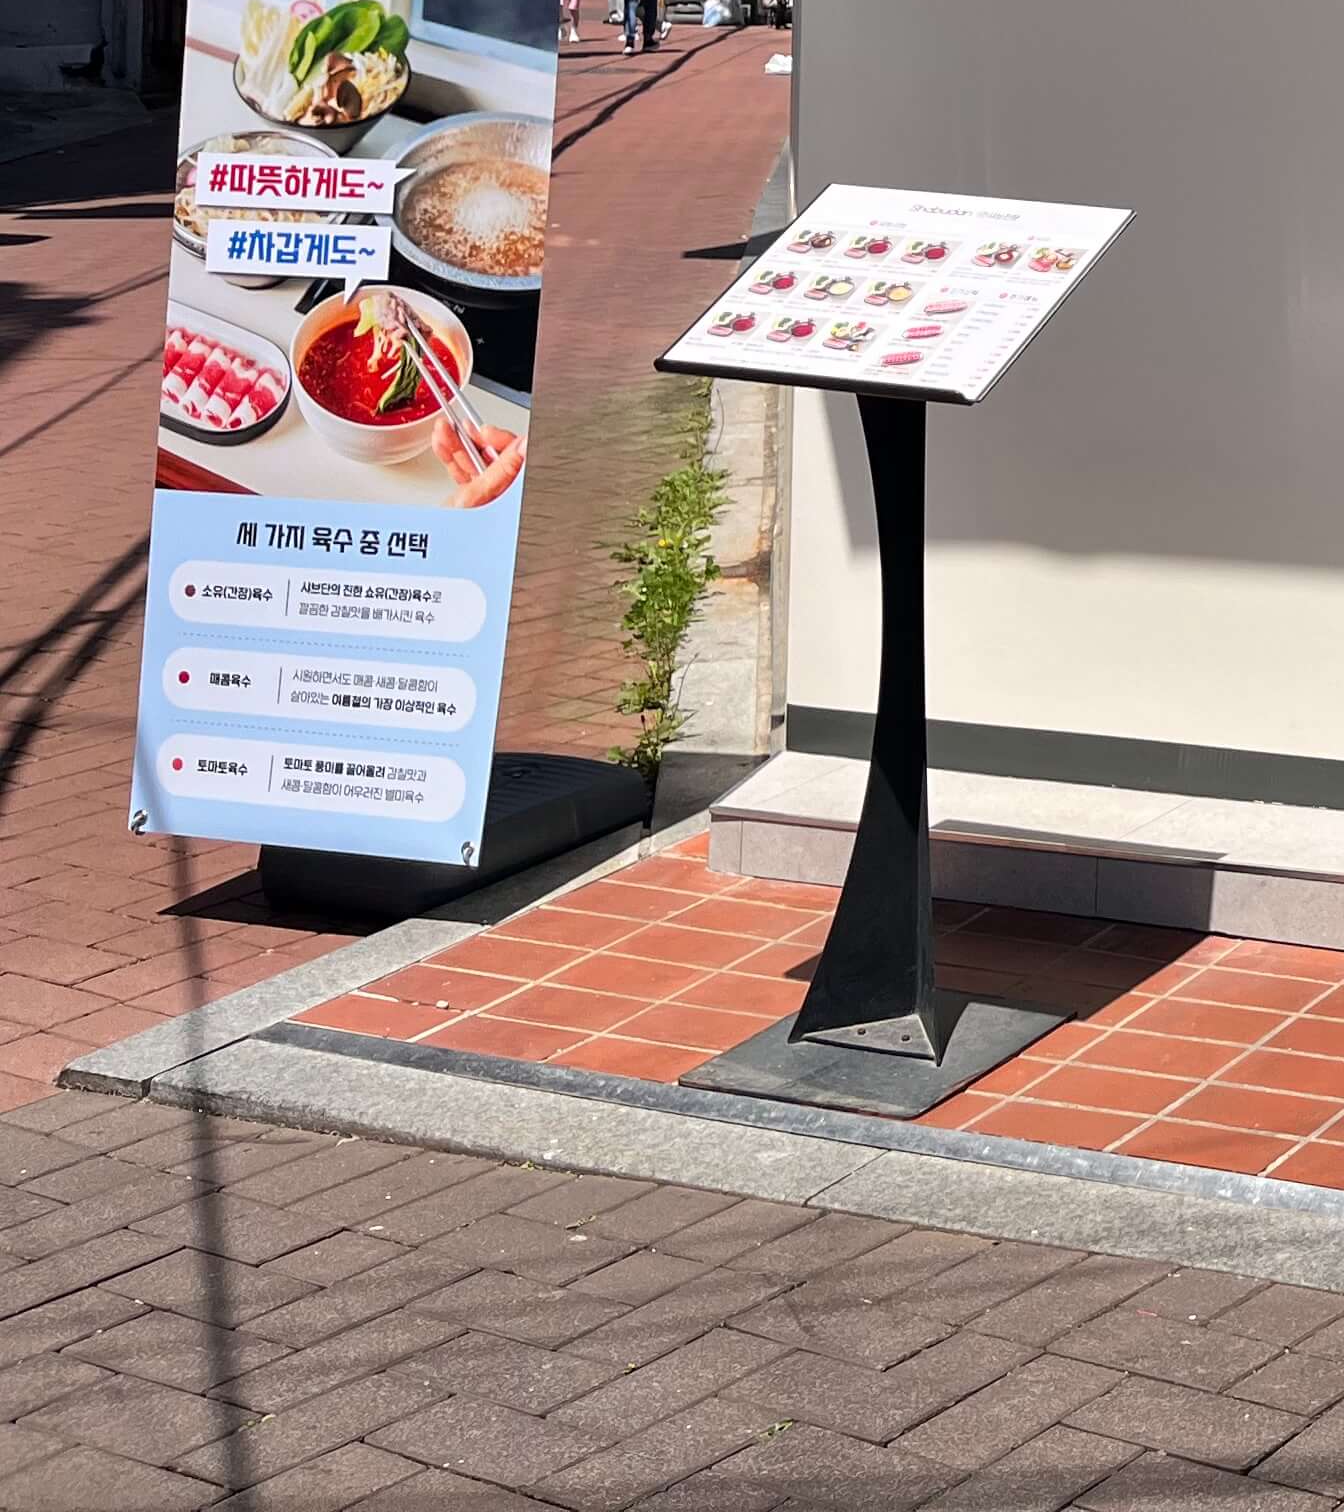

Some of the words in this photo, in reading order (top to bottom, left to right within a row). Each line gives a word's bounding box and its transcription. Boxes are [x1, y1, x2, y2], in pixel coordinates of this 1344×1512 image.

[209, 163, 384, 199] #따뜻하게도~
[227, 229, 376, 265] #차갑게도~
[236, 521, 258, 548] 세
[265, 523, 305, 551] 가지
[312, 526, 353, 554] 육수
[360, 530, 380, 557] 중
[388, 531, 429, 559] 선택
[415, 610, 435, 624] 육수
[292, 669, 352, 686] 시원하면서도
[373, 698, 393, 711] 가장
[395, 699, 435, 714] 이상적인
[437, 702, 457, 715] 육수
[197, 759, 248, 776] 토마토육수
[283, 757, 313, 772] 토마토
